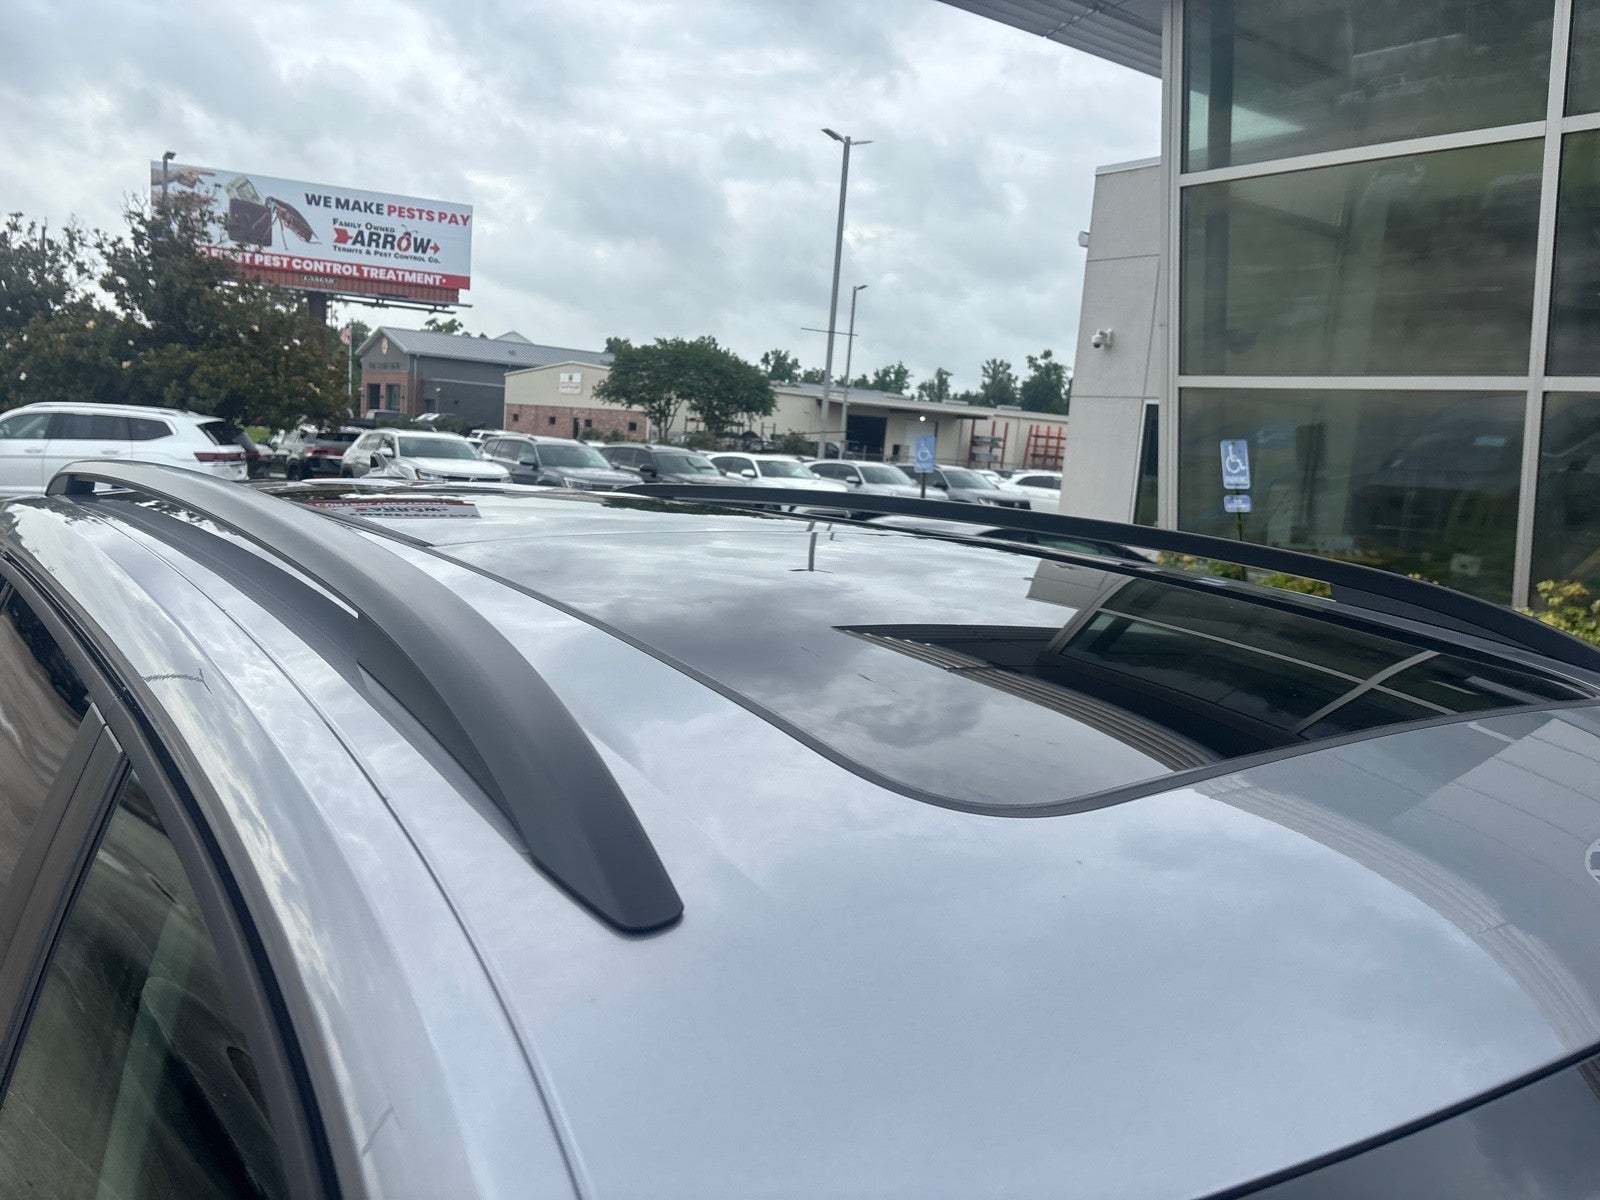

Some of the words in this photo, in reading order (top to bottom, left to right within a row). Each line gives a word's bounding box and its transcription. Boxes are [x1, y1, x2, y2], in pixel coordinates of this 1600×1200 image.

[304, 192, 332, 208] WE
[335, 197, 384, 215] MAKE
[387, 204, 435, 222] PESTS
[438, 211, 471, 226] PAY
[332, 218, 361, 229] FAMILY
[365, 222, 395, 233] OWNED
[333, 245, 362, 254] TERMITE
[373, 250, 391, 258] PEST
[394, 252, 425, 262] CONTROL
[351, 229, 432, 254] ARROW
[255, 252, 290, 268] PEST
[291, 259, 360, 276] CONTROL
[361, 266, 443, 285] TREATMENT
